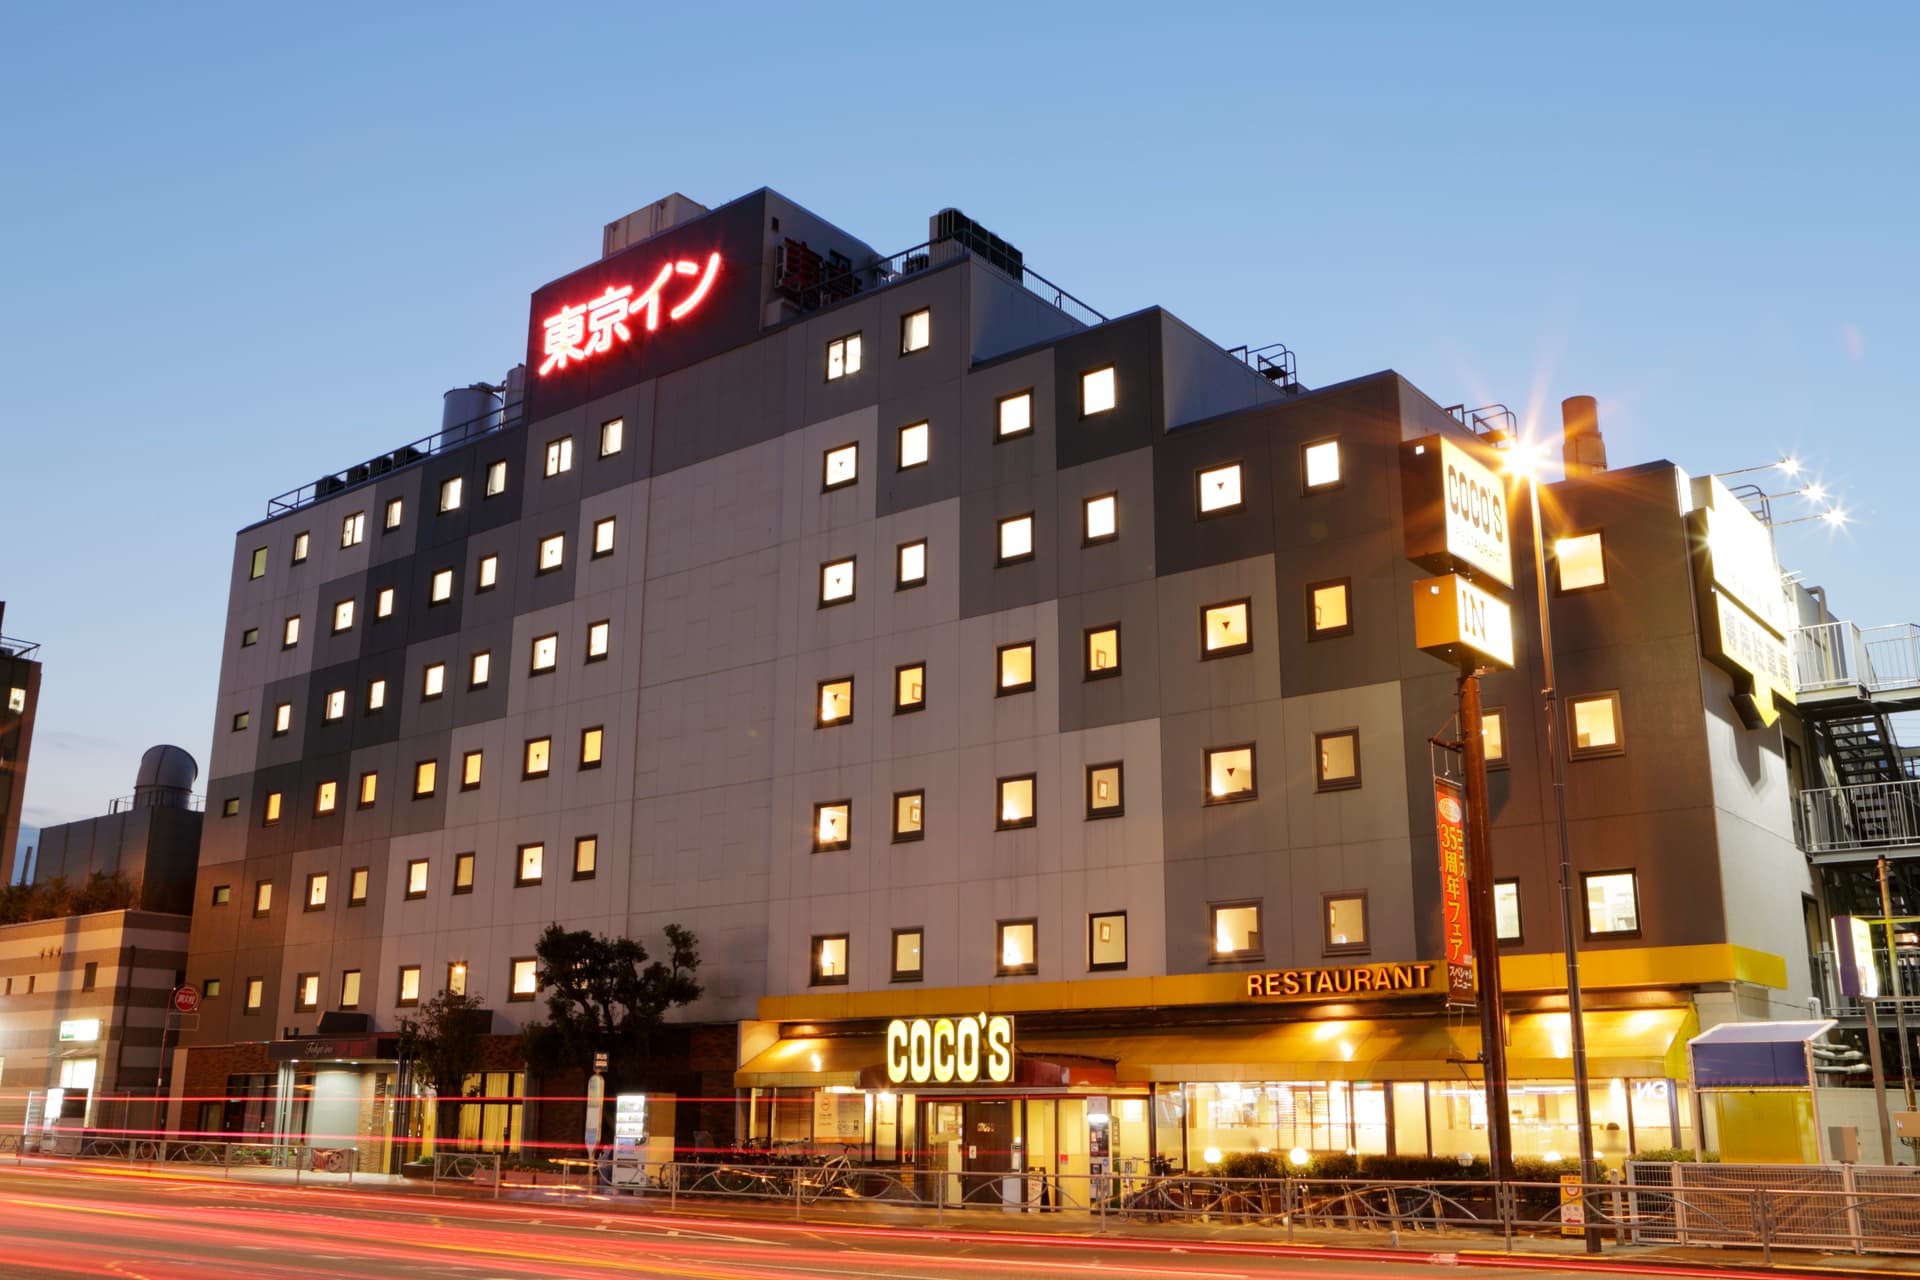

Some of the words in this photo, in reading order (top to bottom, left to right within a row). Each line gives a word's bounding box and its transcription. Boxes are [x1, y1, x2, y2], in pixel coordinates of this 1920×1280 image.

[538, 252, 721, 376] 東京イン
[1448, 464, 1503, 543] COCO'S
[1461, 589, 1487, 642] IN
[1441, 823, 1464, 960] 35周年フェア
[1246, 965, 1432, 997] RESTAURANT
[886, 1011, 1012, 1084] COCO'S
